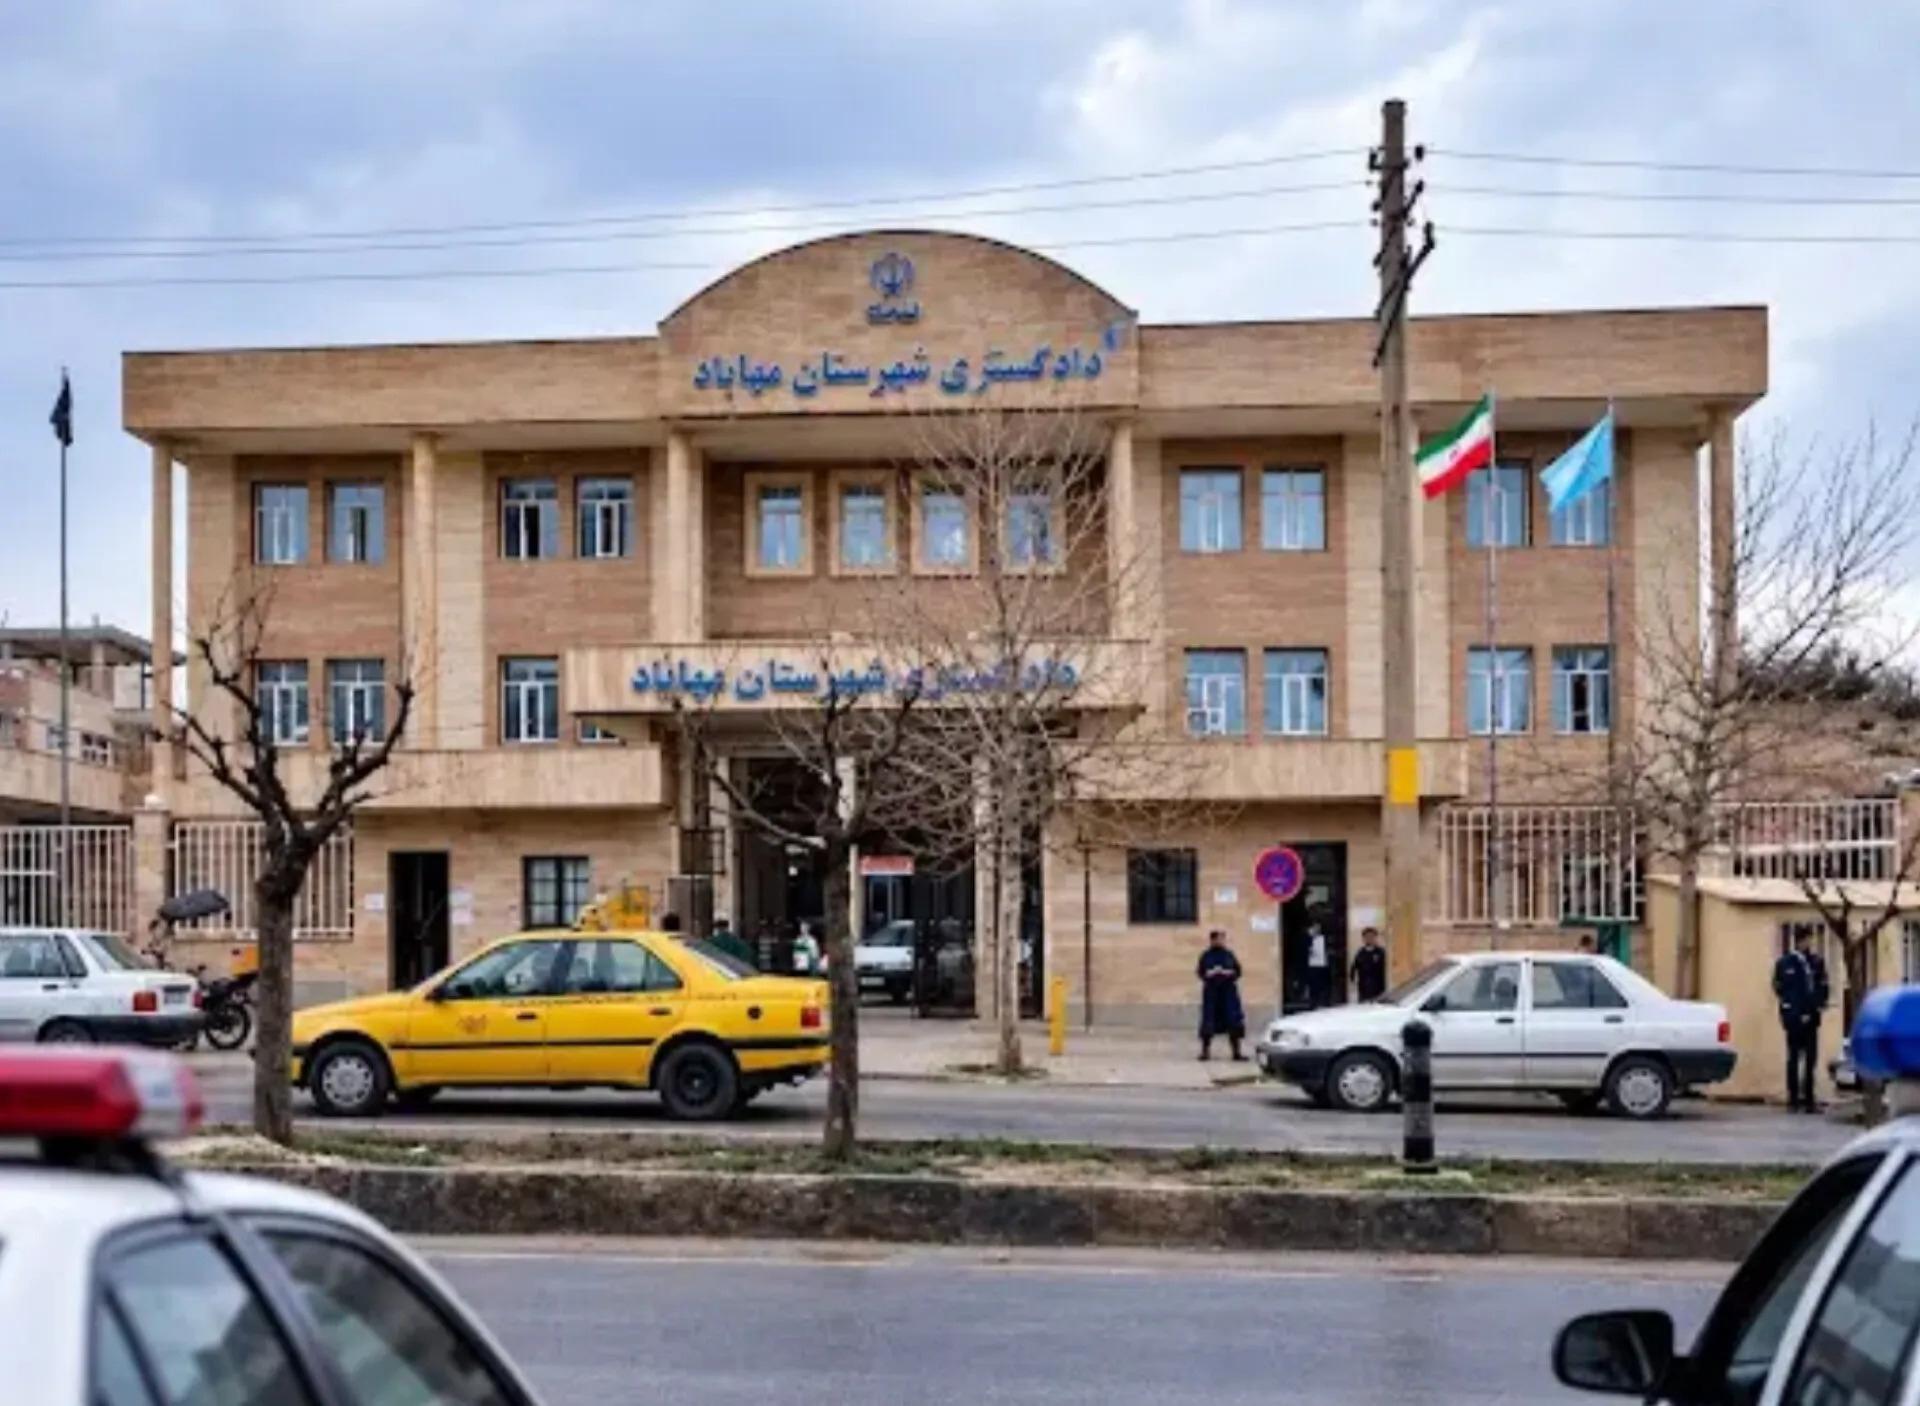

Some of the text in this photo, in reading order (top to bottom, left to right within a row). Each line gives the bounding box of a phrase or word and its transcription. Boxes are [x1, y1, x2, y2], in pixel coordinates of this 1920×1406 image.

[692, 345, 1101, 401] دادگستری شهرستان مهاباد
[735, 656, 886, 703] شهرستان
